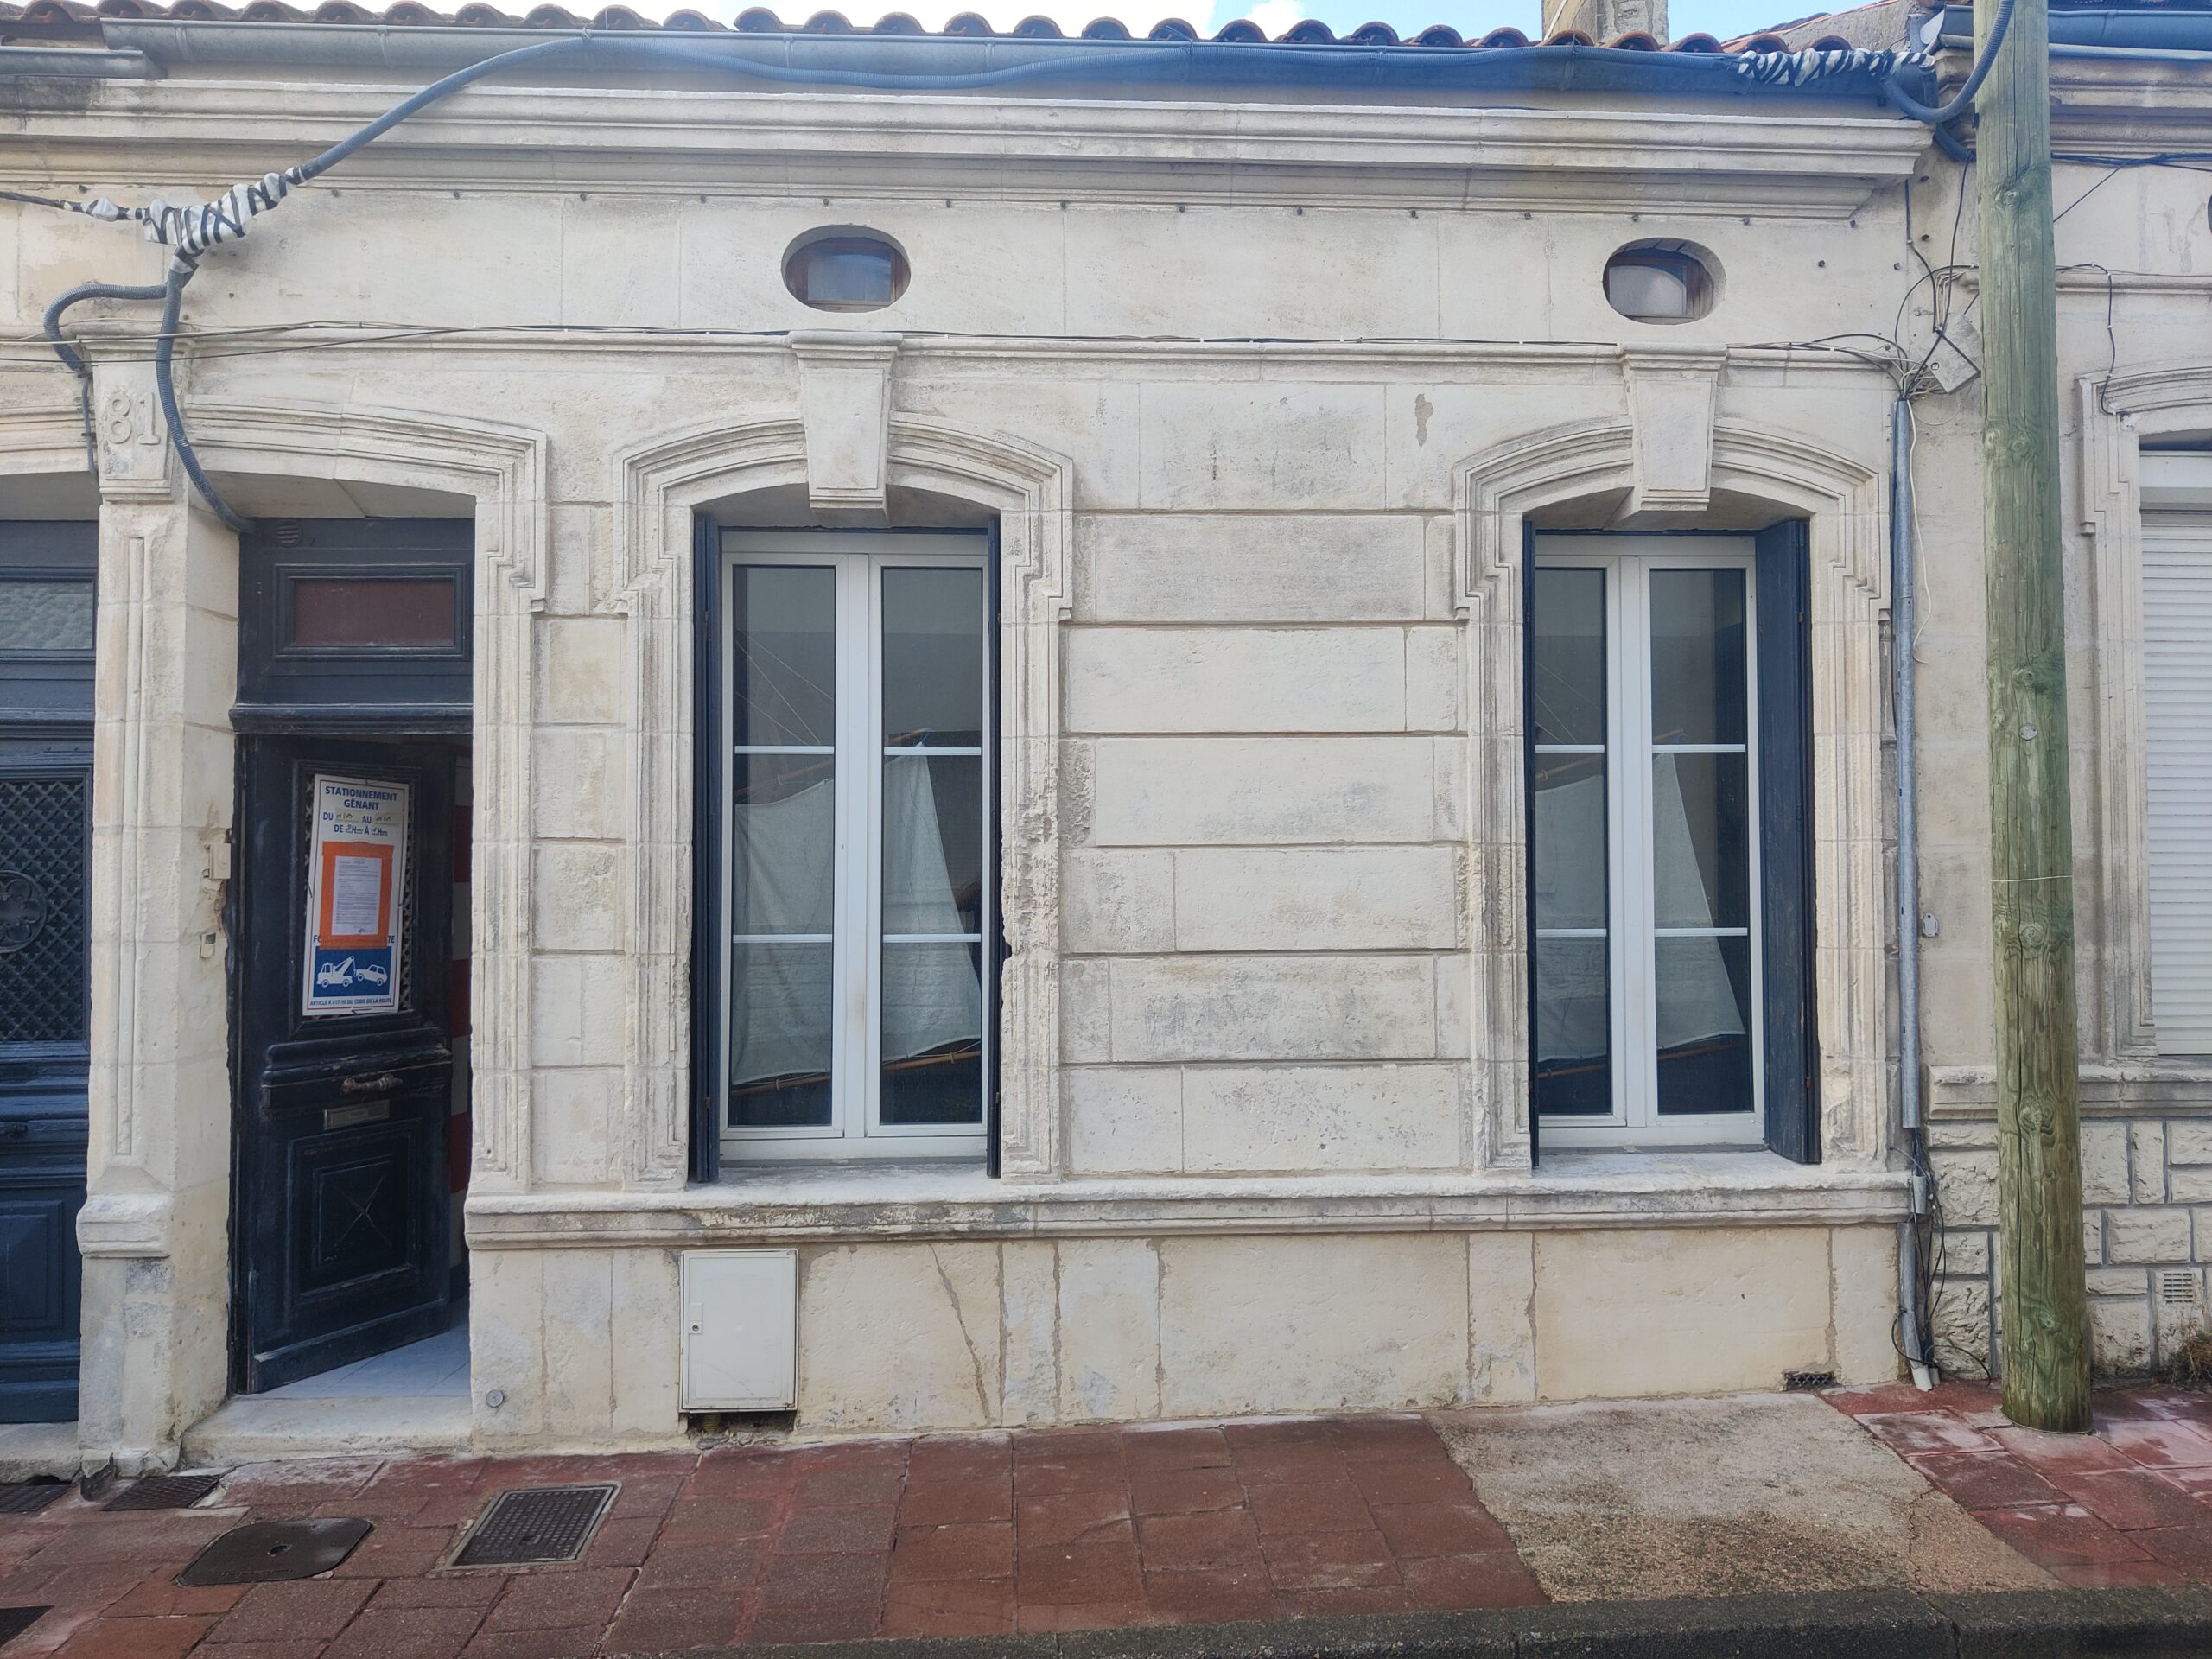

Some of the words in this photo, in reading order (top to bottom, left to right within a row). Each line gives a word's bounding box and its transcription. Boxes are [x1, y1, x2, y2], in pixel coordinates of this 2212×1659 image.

[107, 393, 161, 446] 81
[325, 785, 398, 801] STATIONNEMENT
[344, 798, 379, 810] GÊNANT
[323, 812, 334, 821] DU
[362, 815, 372, 823] AU
[334, 824, 344, 833] DE
